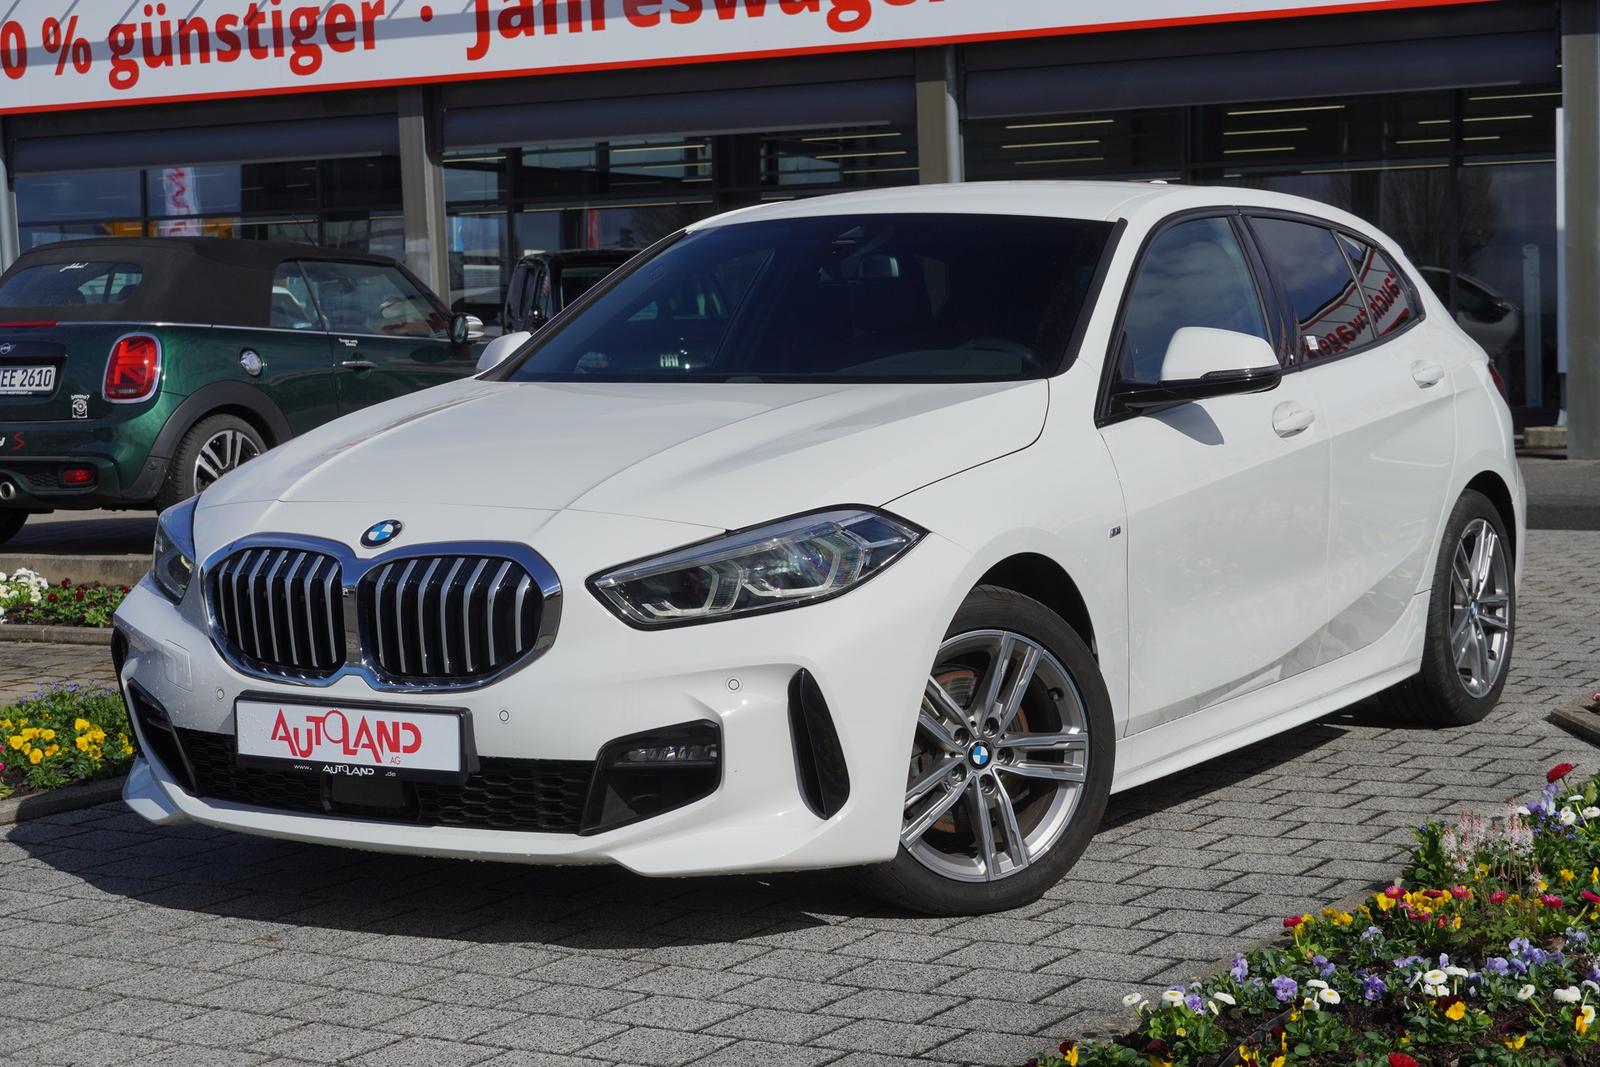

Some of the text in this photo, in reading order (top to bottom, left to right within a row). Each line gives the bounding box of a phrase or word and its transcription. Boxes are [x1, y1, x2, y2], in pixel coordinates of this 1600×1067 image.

[0, 20, 27, 80] 0
[42, 16, 92, 76] %
[108, 0, 385, 90] günstiger
[1, 369, 52, 387] EE 2610
[390, 756, 401, 765] AG
